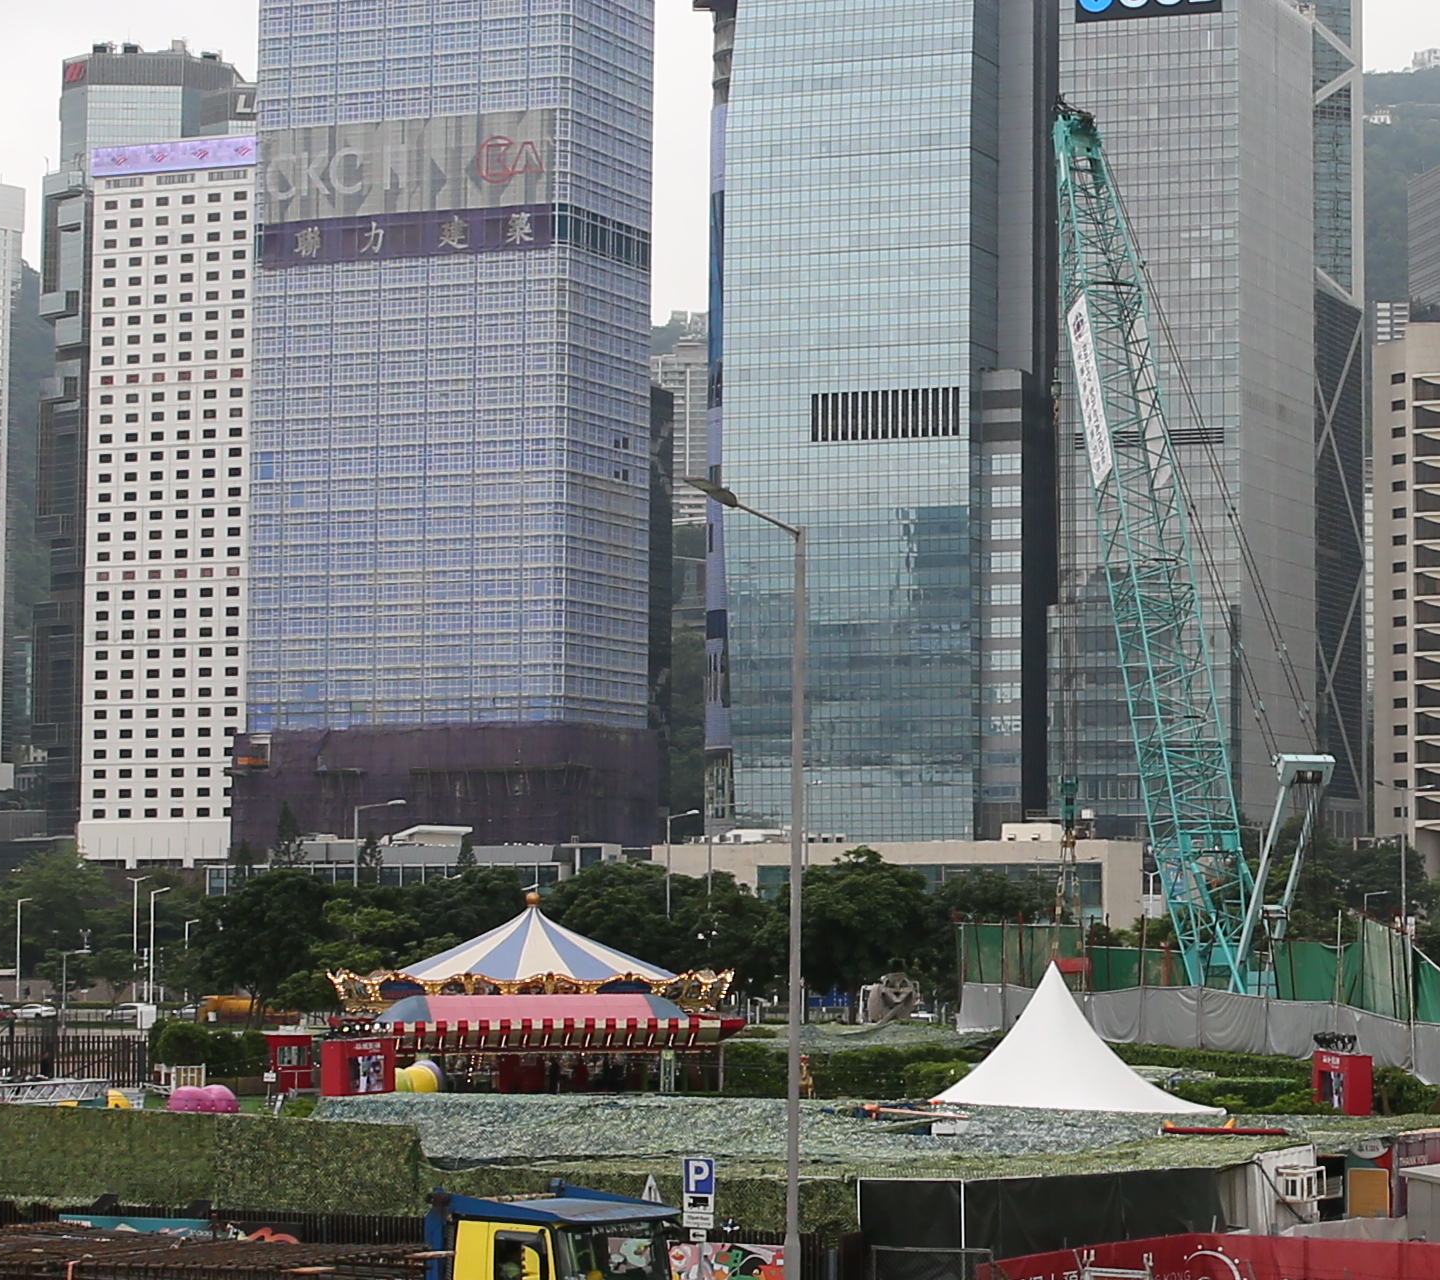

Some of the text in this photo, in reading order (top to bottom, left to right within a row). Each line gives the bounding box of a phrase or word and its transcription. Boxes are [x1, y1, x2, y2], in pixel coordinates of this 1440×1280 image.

[294, 212, 534, 258] 聯力建築
[689, 1160, 710, 1192] P
